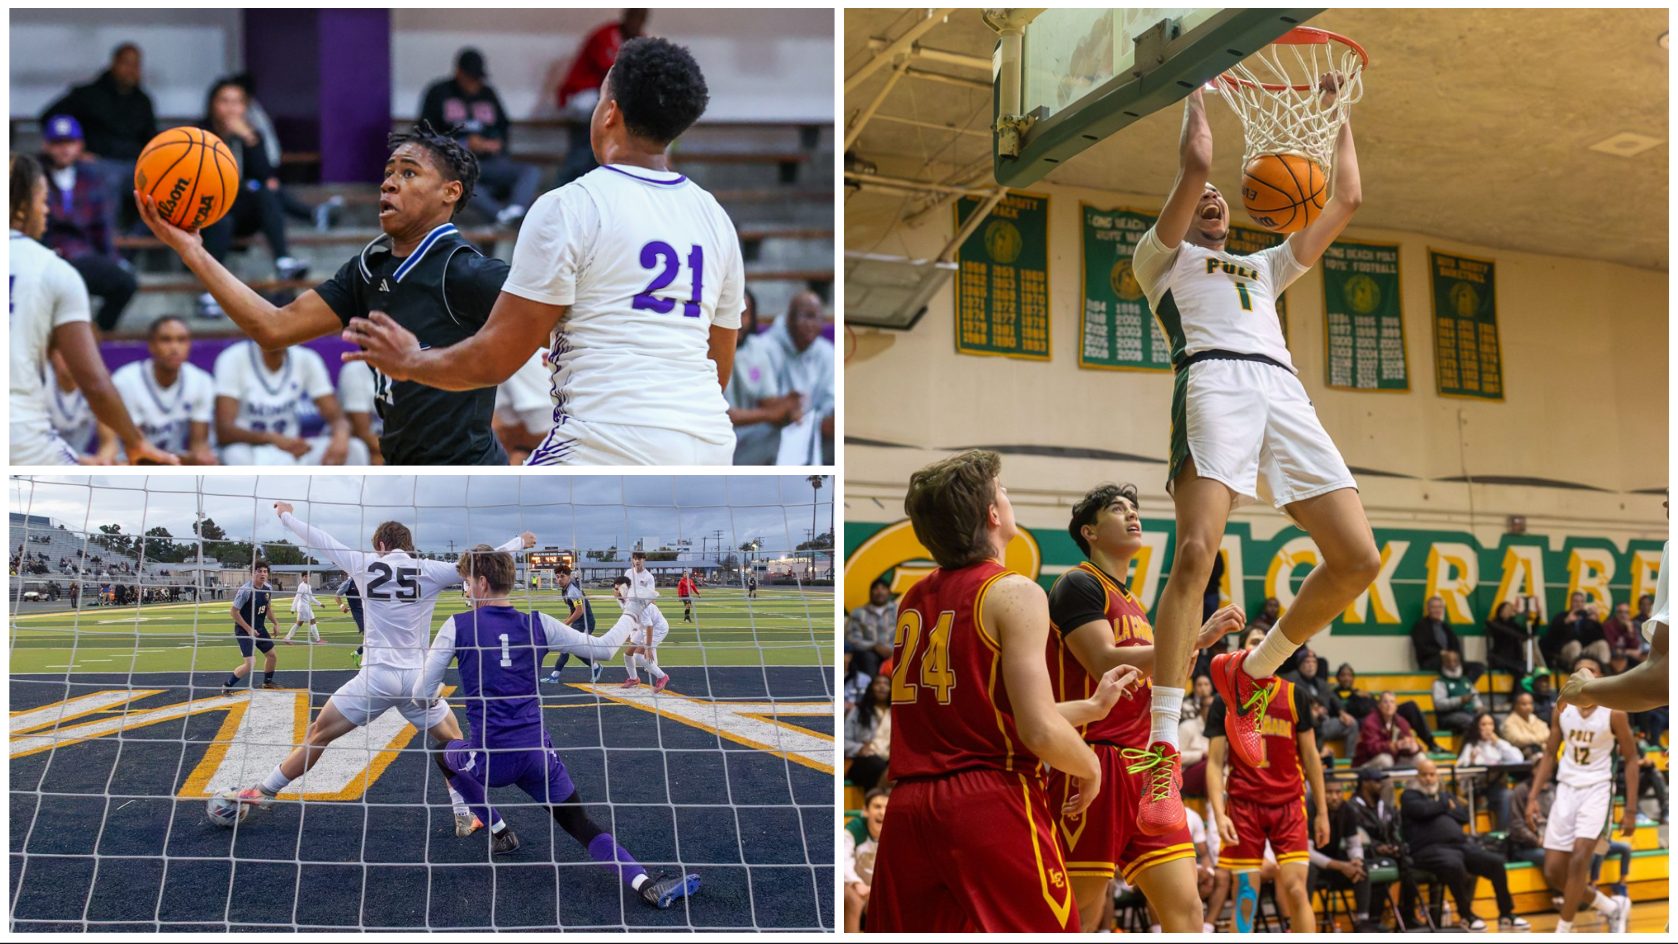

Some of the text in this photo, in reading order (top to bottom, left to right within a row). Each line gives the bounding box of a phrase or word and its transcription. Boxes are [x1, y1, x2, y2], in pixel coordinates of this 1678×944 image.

[632, 240, 704, 318] 21
[1235, 281, 1253, 313] 1
[367, 561, 421, 603] 25
[257, 604, 266, 615] 19
[499, 633, 513, 668] 1
[891, 608, 956, 706] 24
[1569, 729, 1596, 744] POLY
[1573, 746, 1591, 766] 12
[1048, 868, 1065, 888] LC
